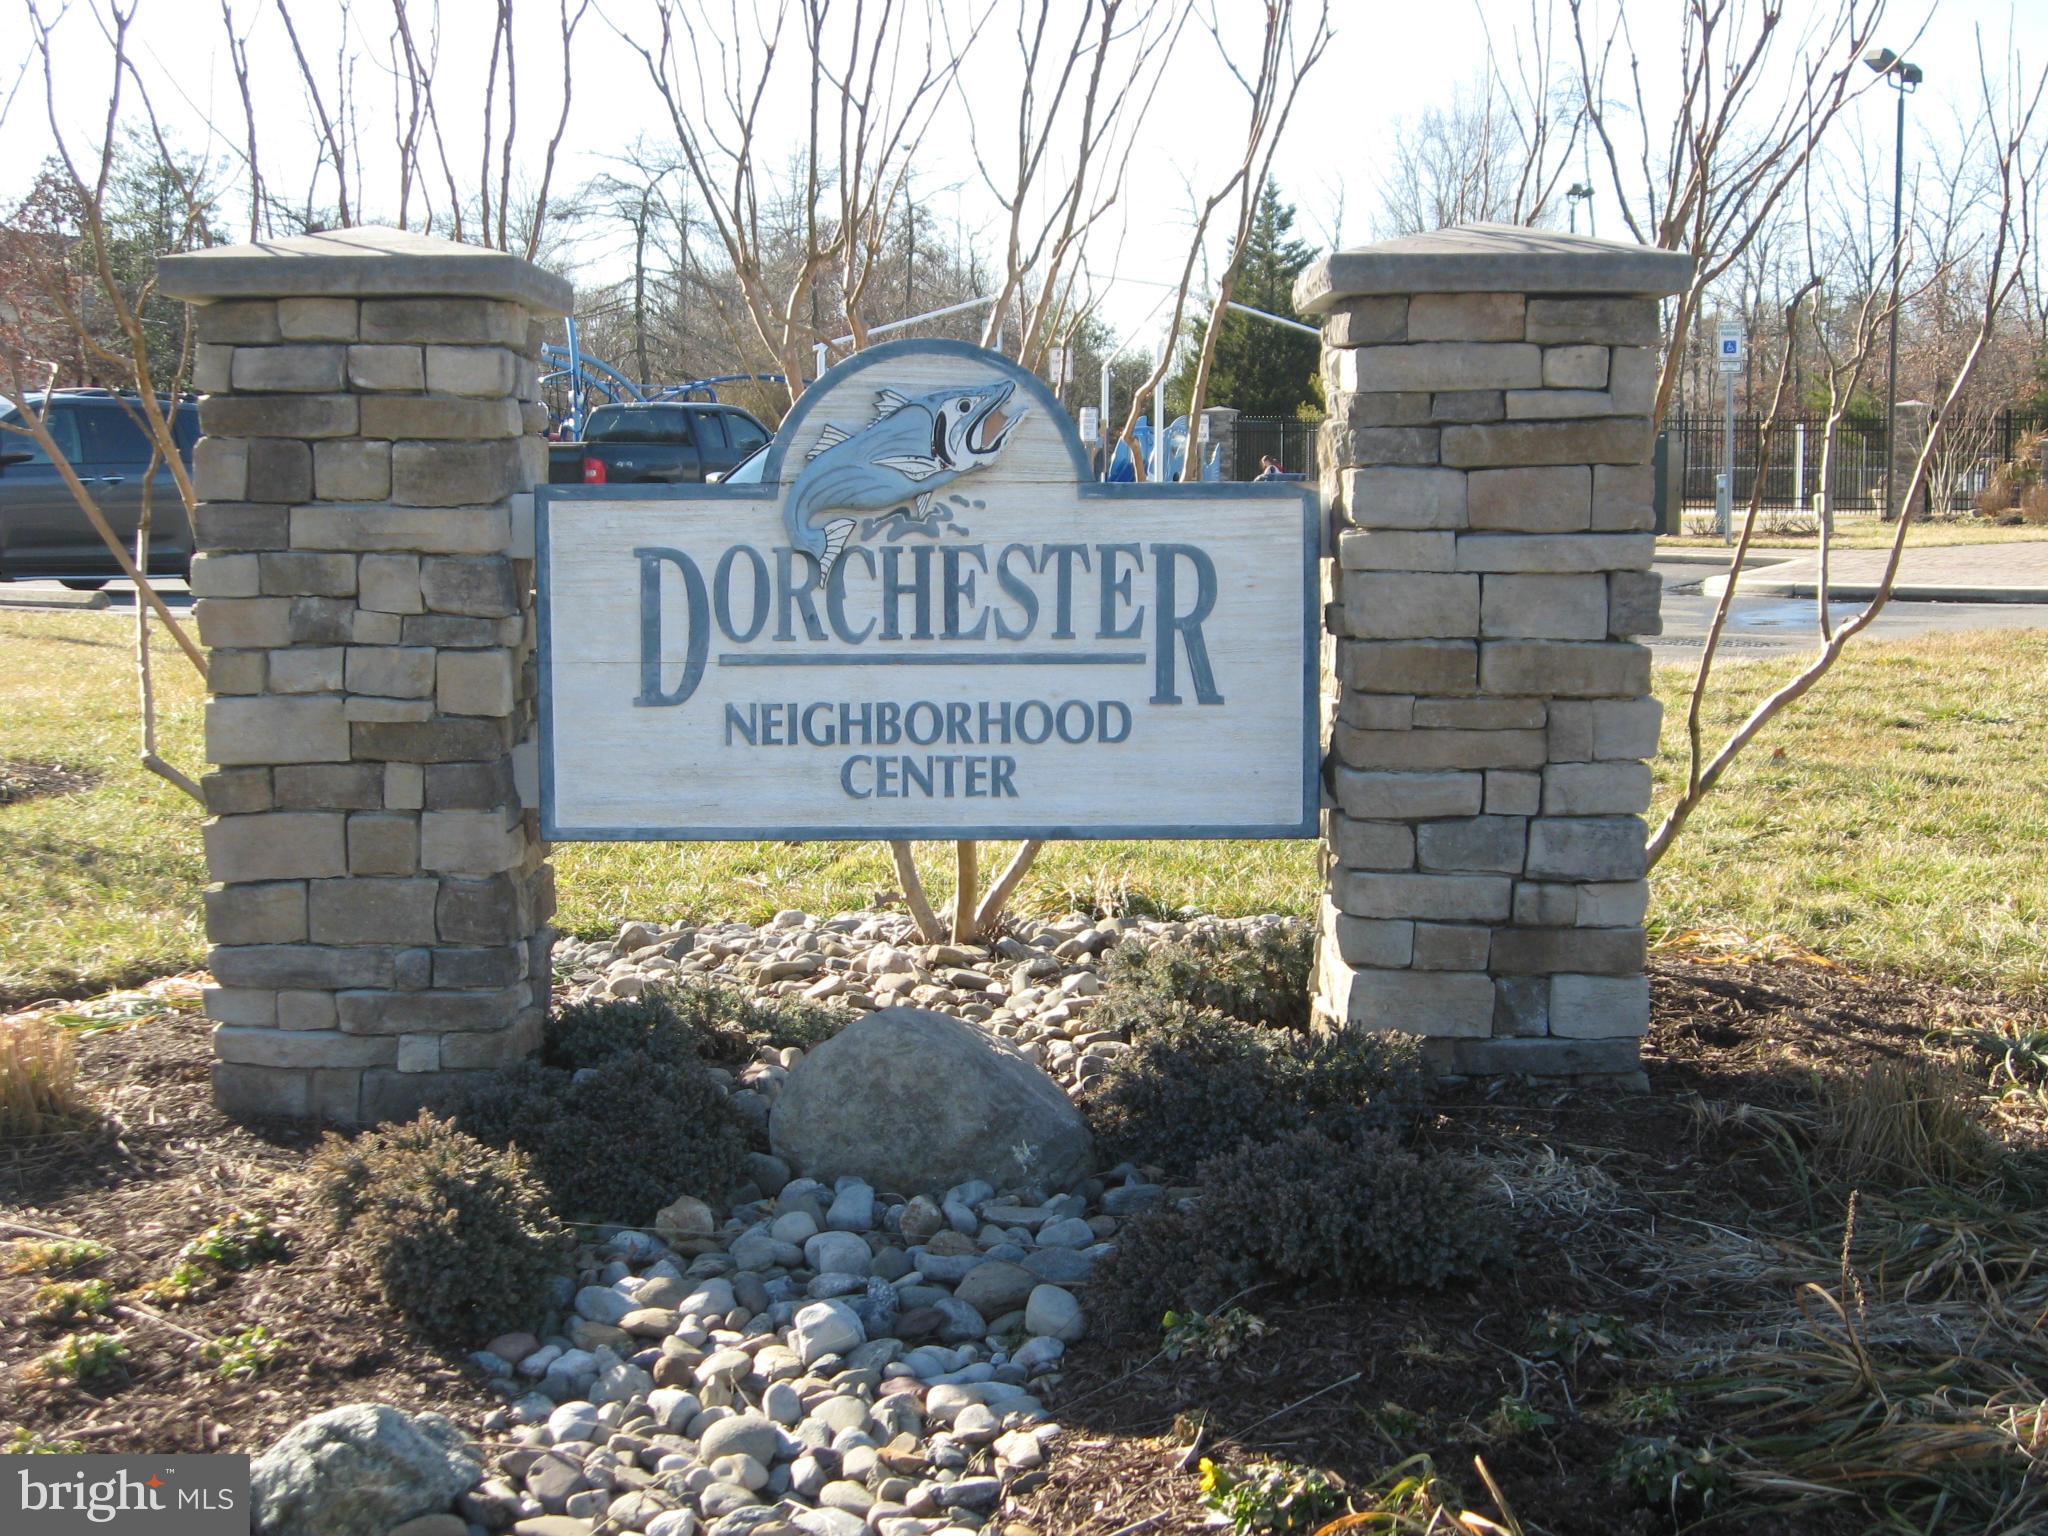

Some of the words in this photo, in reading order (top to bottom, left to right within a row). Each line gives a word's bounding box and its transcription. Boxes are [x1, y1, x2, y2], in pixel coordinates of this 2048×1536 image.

[633, 543, 1225, 707] DORCHESTER
[725, 700, 1132, 746] NEIGHBORHOOD
[840, 754, 1019, 799] CENTER
